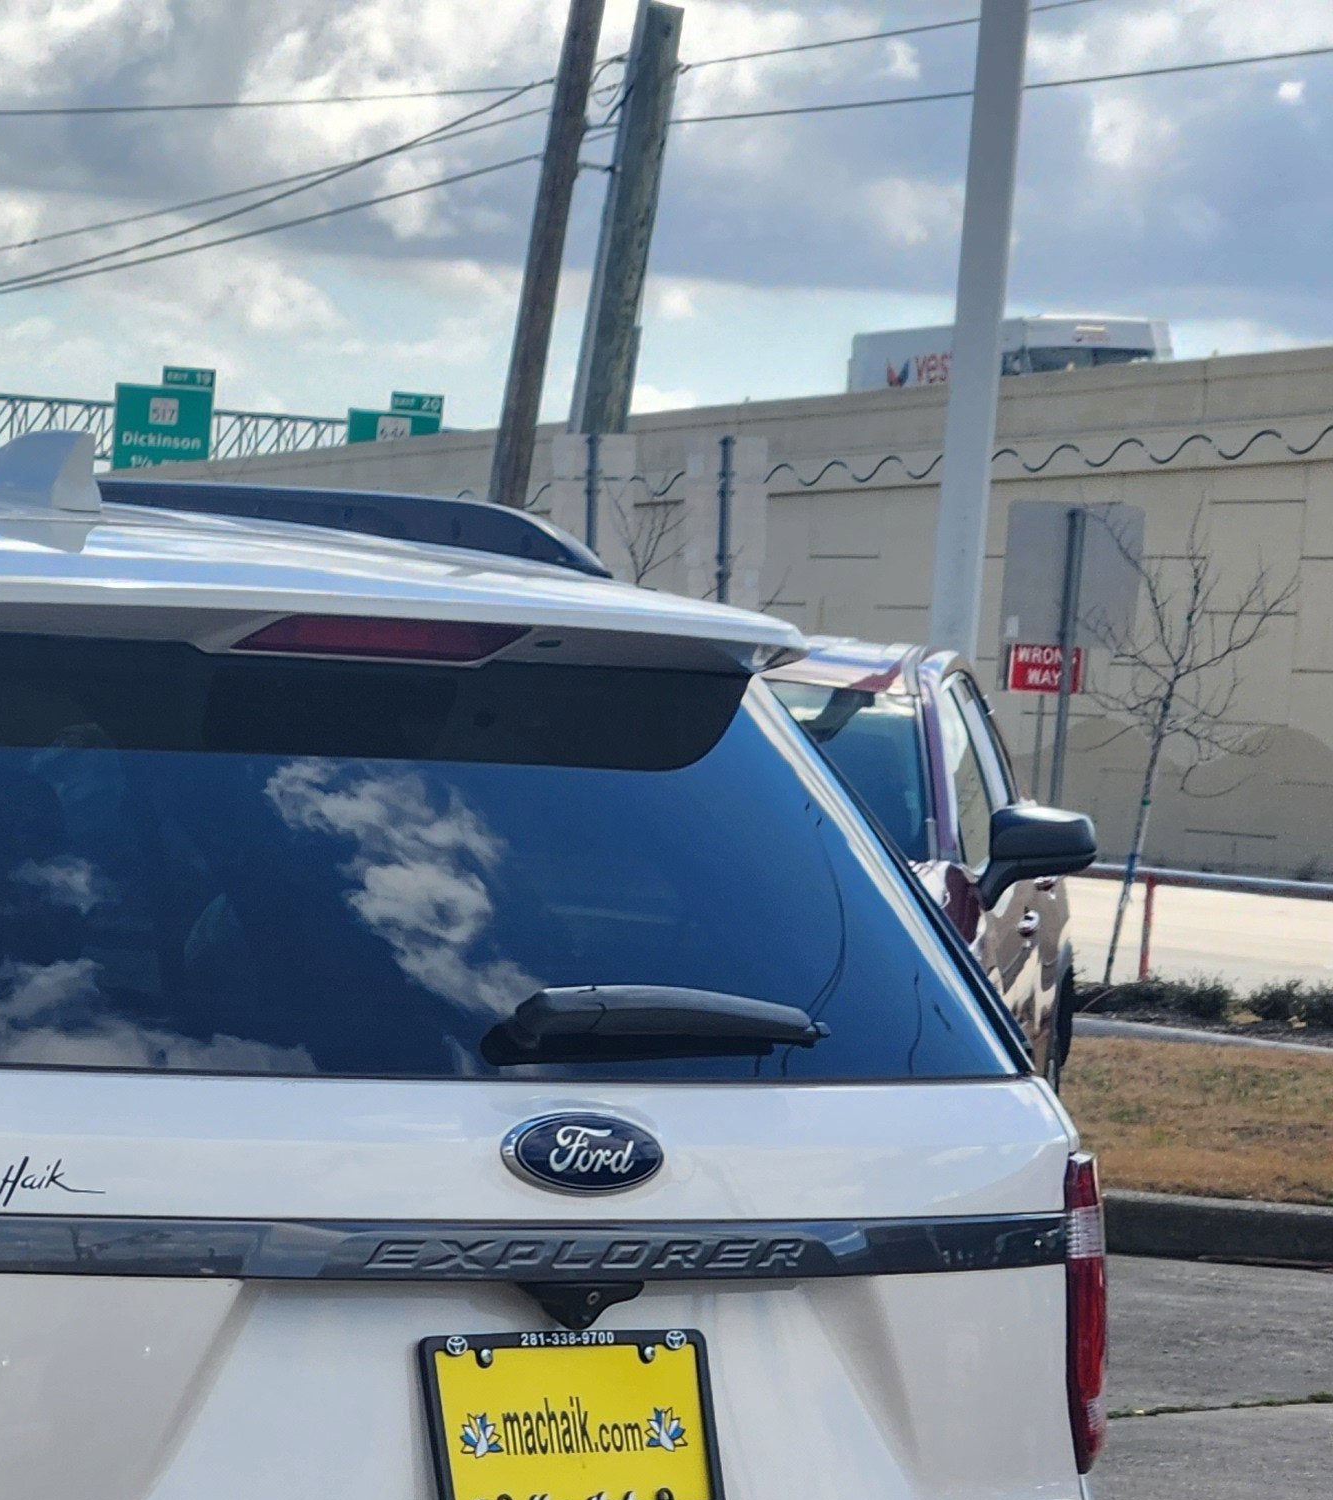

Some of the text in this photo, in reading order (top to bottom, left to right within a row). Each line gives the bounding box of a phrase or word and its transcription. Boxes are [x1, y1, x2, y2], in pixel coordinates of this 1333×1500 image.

[152, 408, 175, 421] 517
[122, 431, 202, 450] Dickinson
[1018, 646, 1076, 665] WRON
[1026, 668, 1063, 686] WAY
[549, 1125, 635, 1174] Ford
[363, 1238, 807, 1272] EXPLORER
[520, 1332, 615, 1346] 281-338-9700
[501, 1397, 644, 1456] machaik.com
